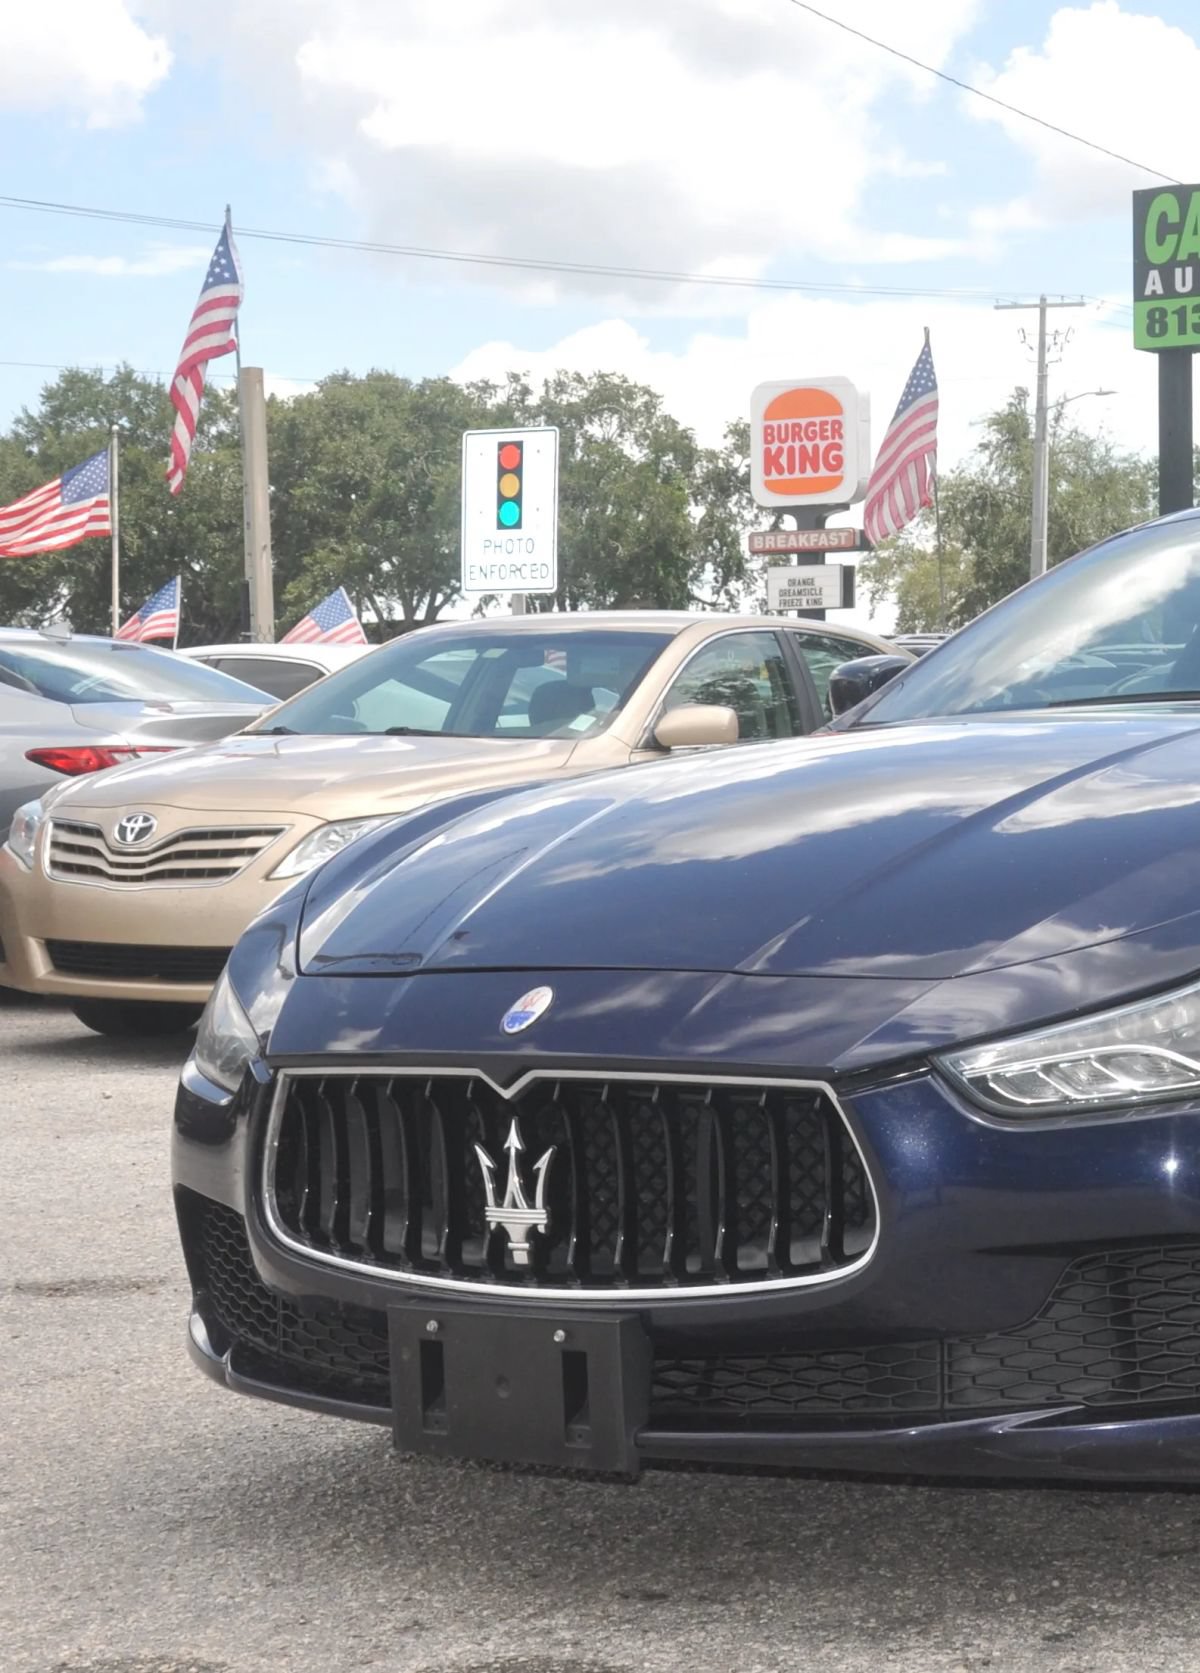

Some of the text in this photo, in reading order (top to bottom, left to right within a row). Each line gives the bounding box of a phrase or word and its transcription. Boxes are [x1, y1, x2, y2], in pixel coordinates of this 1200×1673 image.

[763, 419, 844, 446] BURGER
[763, 441, 844, 477] KING
[483, 537, 535, 555] PHOTO
[753, 531, 849, 550] BREAKFAST
[469, 563, 549, 581] ENFORCED
[787, 577, 816, 588] ORANGE
[778, 586, 823, 598] DREAMSICLE
[778, 597, 823, 608] FREEZE KING
